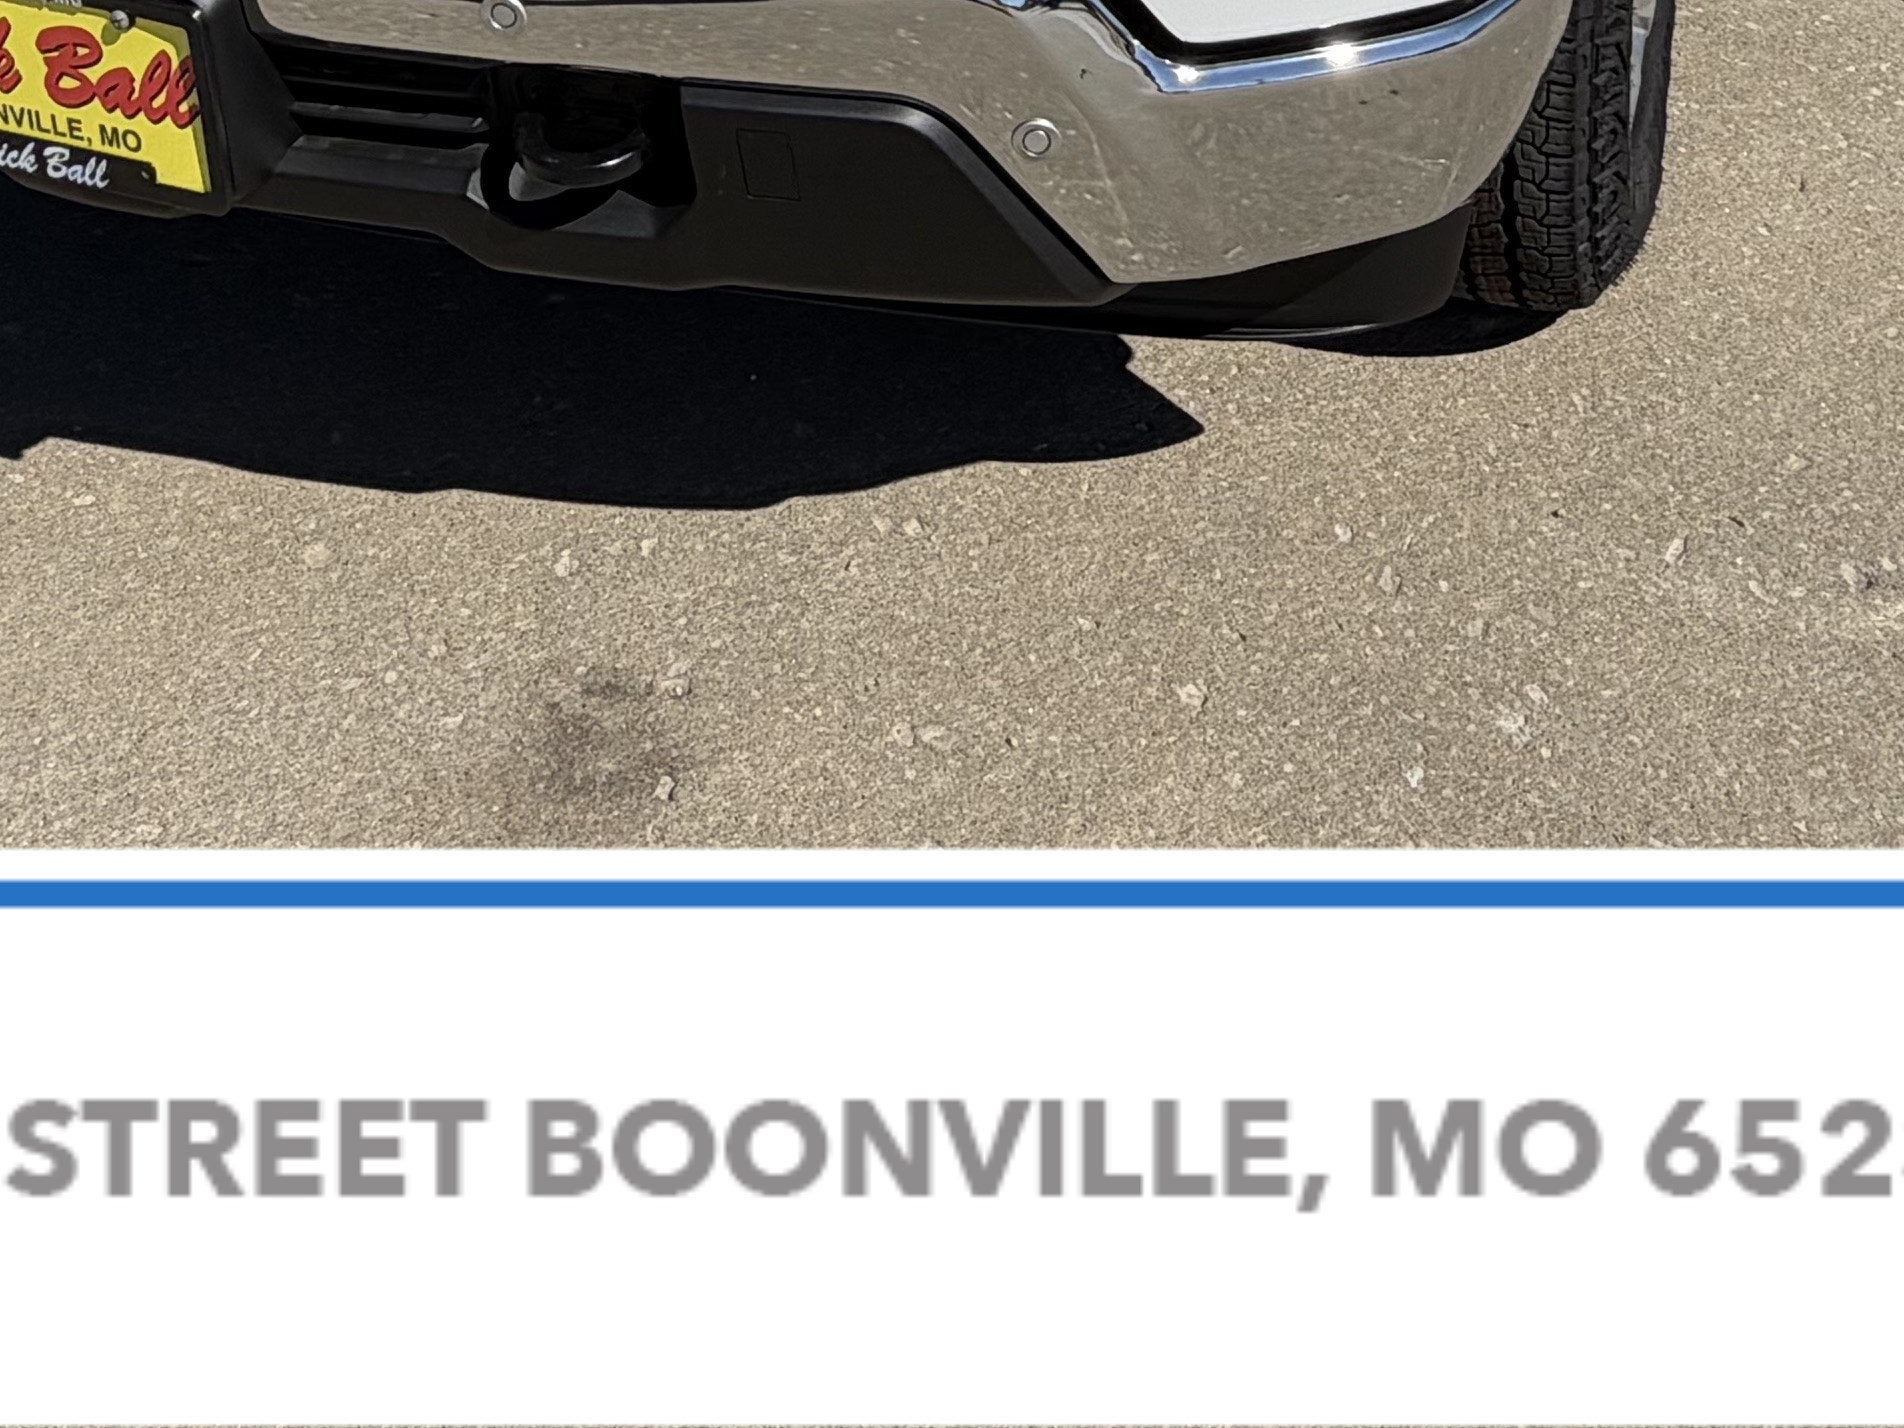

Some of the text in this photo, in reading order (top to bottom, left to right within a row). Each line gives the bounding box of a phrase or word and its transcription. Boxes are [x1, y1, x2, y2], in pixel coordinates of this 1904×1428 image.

[34, 24, 200, 130] Ball
[98, 123, 143, 153] MO
[42, 145, 110, 189] Ball
